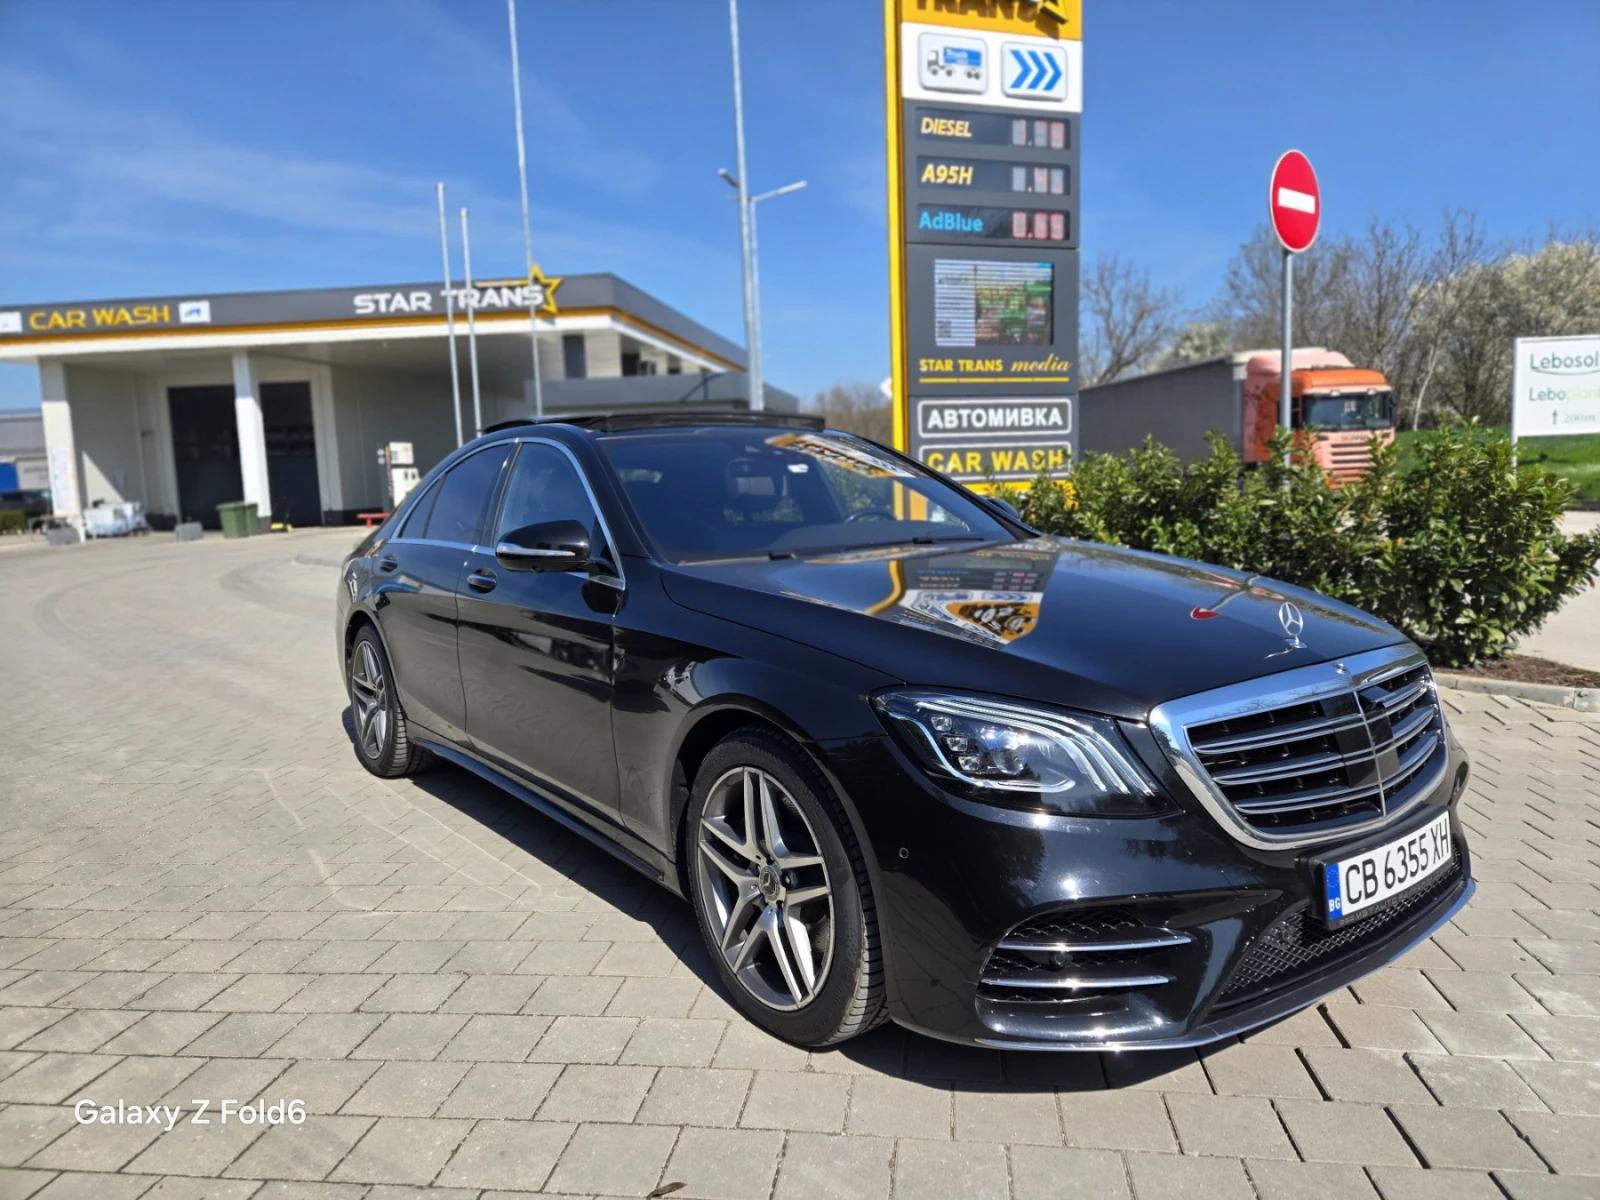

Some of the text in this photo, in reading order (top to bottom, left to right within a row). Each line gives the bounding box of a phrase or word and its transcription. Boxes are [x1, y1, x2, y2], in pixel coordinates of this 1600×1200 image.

[920, 116, 972, 138] DIESEL
[921, 163, 973, 185] A95H
[919, 211, 984, 232] AdBlue
[353, 291, 432, 315] STAR
[29, 304, 171, 331] CAR WASH
[919, 353, 1070, 372] STAR TRANS media
[1530, 350, 1599, 370] Lebosol
[927, 407, 1063, 429] АВТОМИВКА
[927, 448, 1064, 473] CAR WASH
[1345, 858, 1378, 905] CB
[1384, 833, 1429, 889] 6355
[1430, 818, 1449, 865] XH
[1328, 897, 1341, 912] BG
